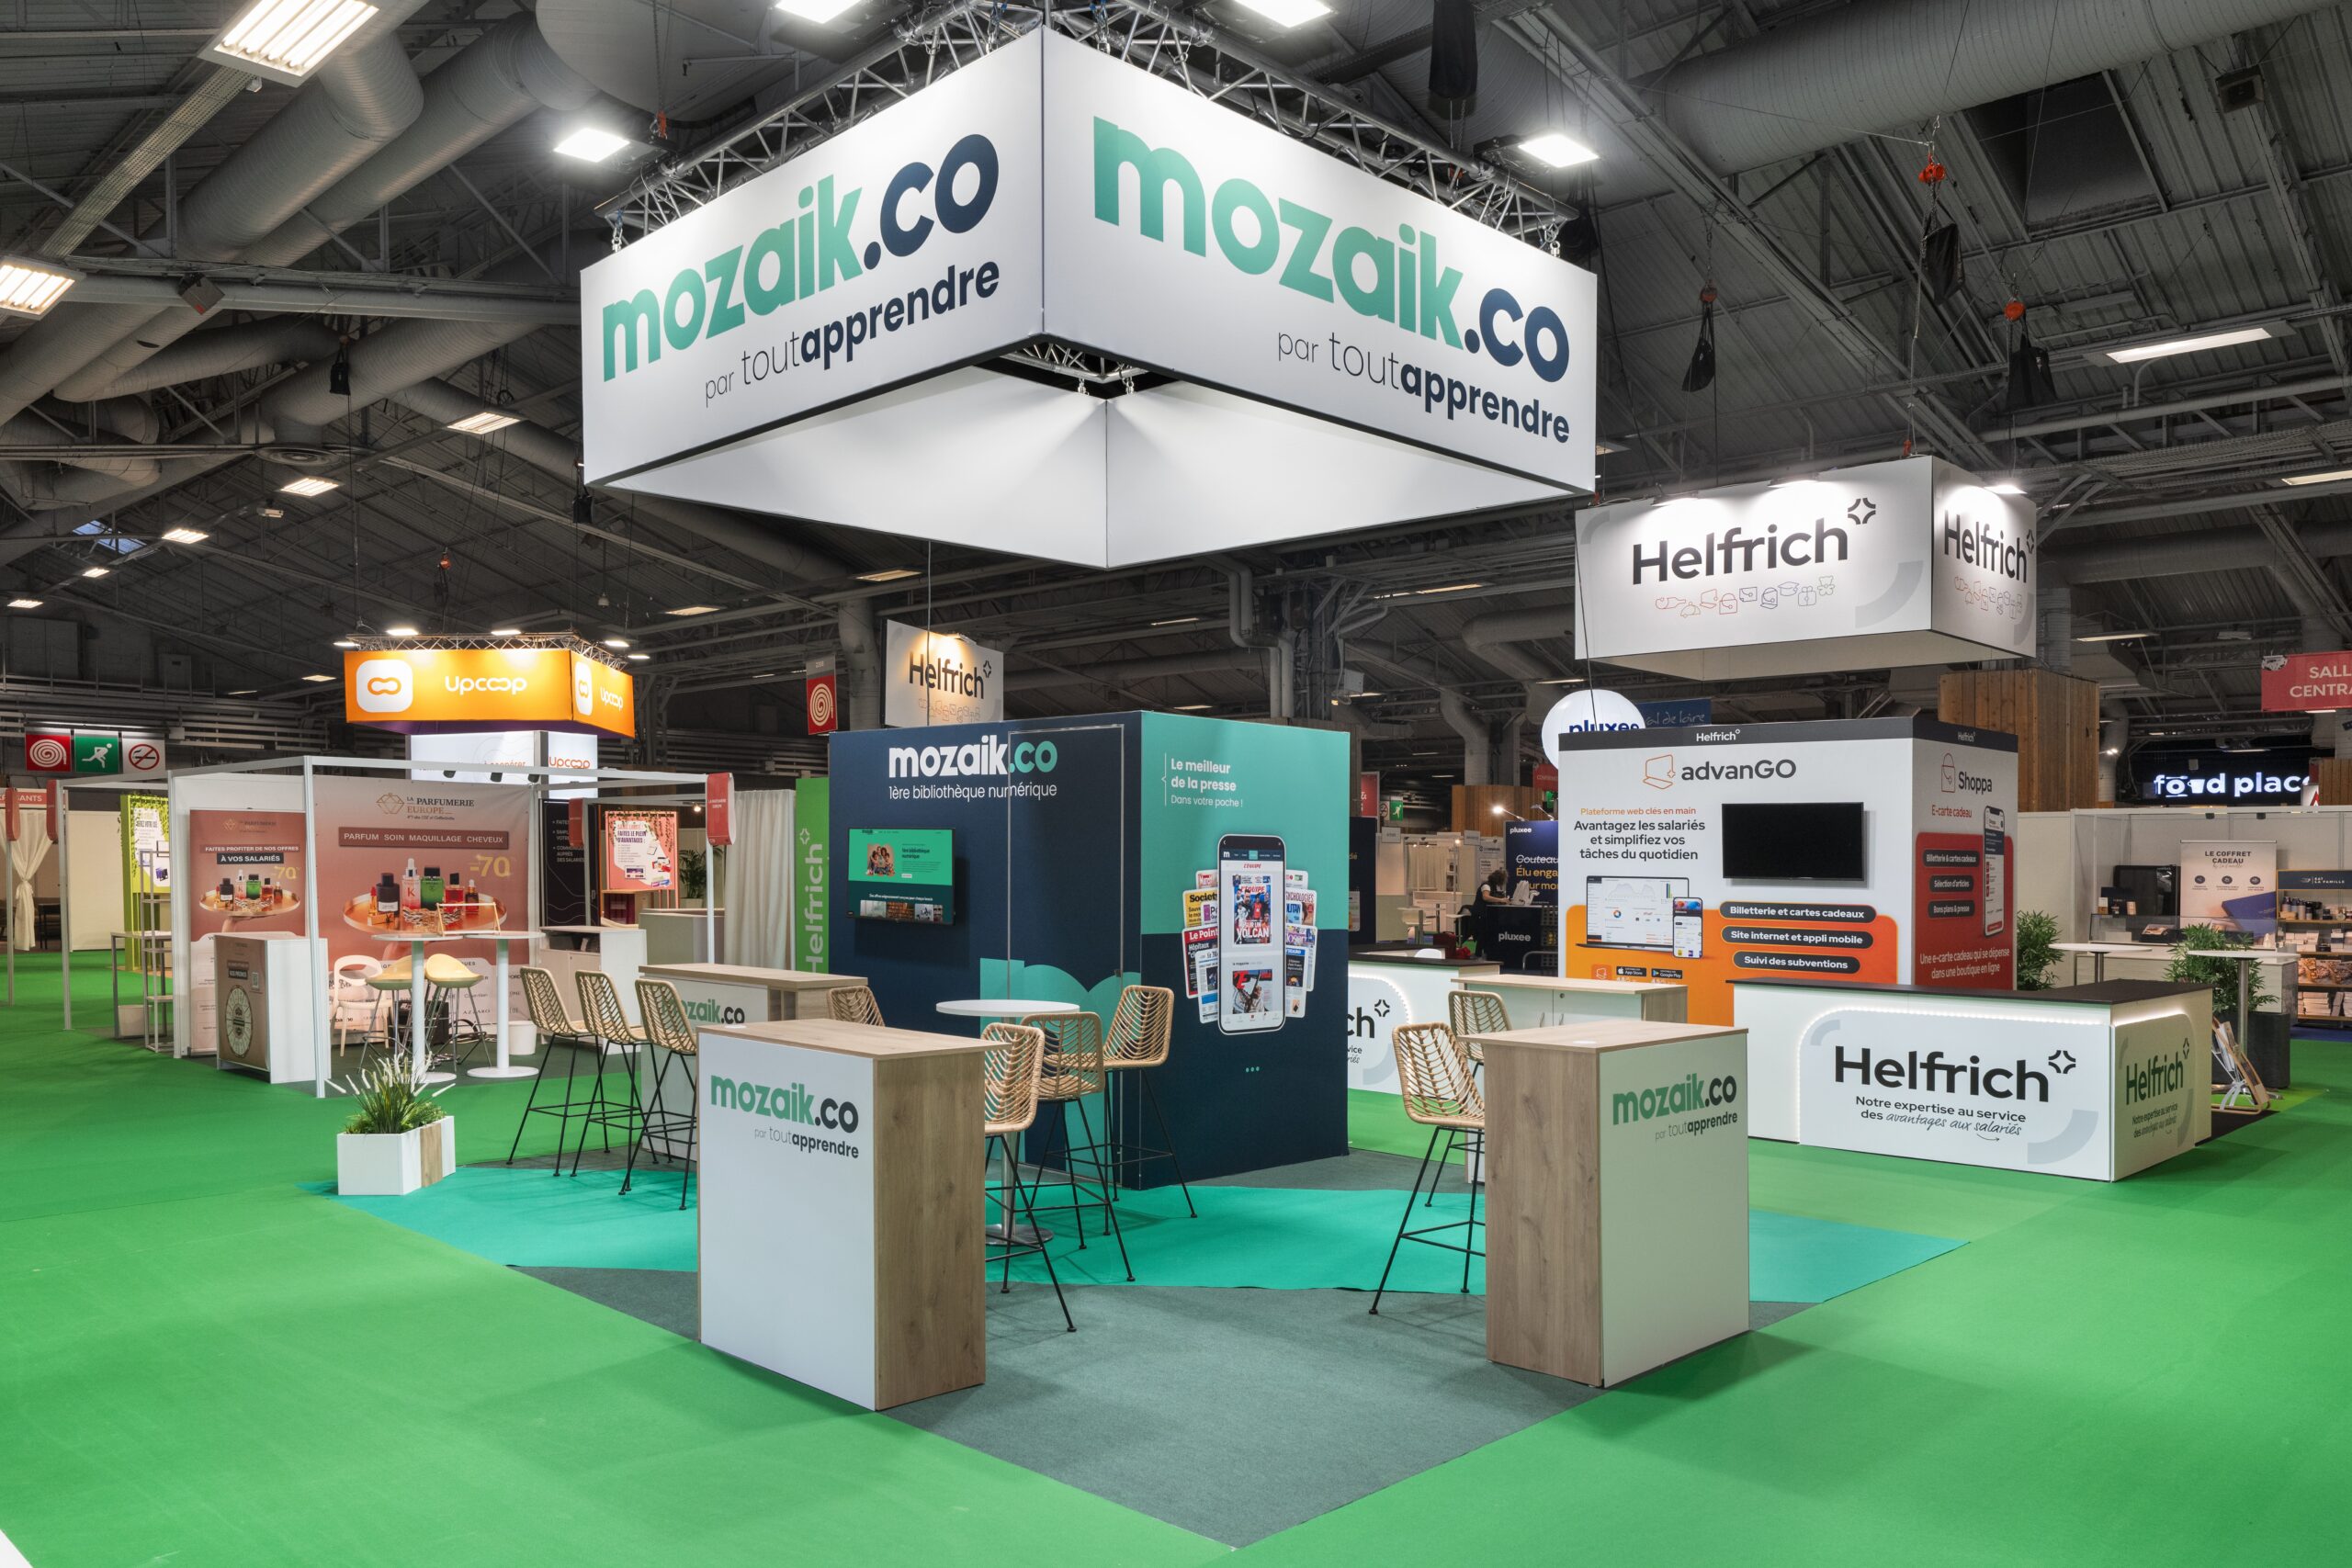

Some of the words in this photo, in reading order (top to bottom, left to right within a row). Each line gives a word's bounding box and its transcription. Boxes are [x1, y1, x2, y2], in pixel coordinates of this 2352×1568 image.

[603, 134, 999, 382] mozaik.co
[1093, 116, 1569, 383] mozaik.co
[706, 369, 734, 408] par
[741, 261, 1000, 385] toutapprendre
[1278, 332, 1318, 363] par
[1329, 332, 1569, 444] toutapprendre
[1633, 517, 1849, 585] Helfrich
[1944, 509, 2027, 583] Helfrich
[909, 650, 984, 699] Helfrich
[2290, 682, 2352, 698] CENTR
[1696, 731, 1736, 742] Helfrich
[888, 734, 1057, 778] mozaik.co
[1171, 758, 1183, 771] Le
[1185, 760, 1230, 774] meilleur
[1681, 759, 1796, 781] advanGO
[1171, 776, 1185, 788] de
[1187, 777, 1198, 789] la
[1200, 780, 1237, 793] presse
[1958, 771, 1992, 795] Shoppa
[2234, 772, 2310, 796] plac
[888, 785, 909, 799] 1ère
[912, 783, 985, 803] bibliothèque
[989, 782, 1057, 801] numérique
[416, 798, 474, 807] PARFUMERIE
[1171, 795, 1192, 805] Dans
[1193, 797, 1214, 806] votre
[1215, 797, 1239, 808] poche
[1580, 807, 1625, 816] Plateforme
[1627, 807, 1644, 816] web
[1645, 807, 1661, 815] clés
[1932, 804, 1952, 817] E-carte
[1953, 807, 1972, 818] cadeau
[1574, 820, 1635, 833] Avantagez
[1638, 820, 1656, 830] les
[1657, 819, 1705, 830] salariés
[409, 834, 462, 842] MAQUILLAGE
[1590, 836, 1602, 845] et
[1604, 834, 1661, 849] simplifiez
[1663, 836, 1685, 845] vos
[1580, 849, 1619, 859] tâches
[1622, 850, 1635, 859] du
[1638, 849, 1698, 862] quotidien
[1926, 853, 1946, 862] Billetterie
[1950, 854, 1961, 863] cartes
[1516, 864, 1531, 876] Élu
[1934, 879, 1951, 887] Sélection
[1951, 879, 1970, 887] d'articles
[804, 843, 823, 973] Helfrich
[1730, 906, 1776, 915] Billetterie
[1778, 907, 1788, 916] et
[1790, 908, 1820, 917] cartes
[1822, 908, 1864, 919] cadeaux
[1933, 905, 1944, 913] Bons
[1957, 906, 1970, 914] presse
[1189, 931, 1198, 941] Le
[1236, 927, 1269, 938] VOLCAN
[1498, 931, 1531, 942] pluxee
[1731, 931, 1749, 939] Site
[1751, 931, 1789, 941] internet
[1803, 934, 1826, 943] appli
[1828, 934, 1862, 944] mobile
[1744, 956, 1768, 964] Suivi
[1769, 957, 1786, 965] des
[1787, 958, 1848, 969] subventions
[1919, 953, 1931, 964] Une
[1932, 952, 1953, 963] e-carte
[1953, 949, 1973, 961] cadeau
[1973, 948, 1982, 962] qui
[1983, 950, 1988, 958] se
[1988, 946, 2009, 960] dépense
[1931, 967, 1945, 979] dans
[1945, 967, 1956, 977] une
[1957, 964, 1980, 977] boutique
[1981, 965, 1987, 975] en
[1988, 962, 2000, 976] ligne
[1836, 1045, 2049, 1102] Helfrich
[2126, 1051, 2183, 1105] Helfrich
[710, 1075, 858, 1133] mozaik.co
[1612, 1073, 1736, 1125] mozaik.co
[1856, 1096, 1891, 1109] Notre
[1894, 1100, 1955, 1115] expertise
[1958, 1108, 1973, 1118] au
[1976, 1109, 2026, 1122] service
[1655, 1131, 1667, 1142] par
[1668, 1111, 1737, 1137] toutapprendre
[1860, 1109, 1883, 1121] des
[1886, 1112, 1947, 1130] avantages
[1950, 1119, 1972, 1131] aux
[1974, 1121, 2022, 1135] salariés
[754, 1127, 766, 1139] par
[769, 1126, 859, 1158] toutapprendre
